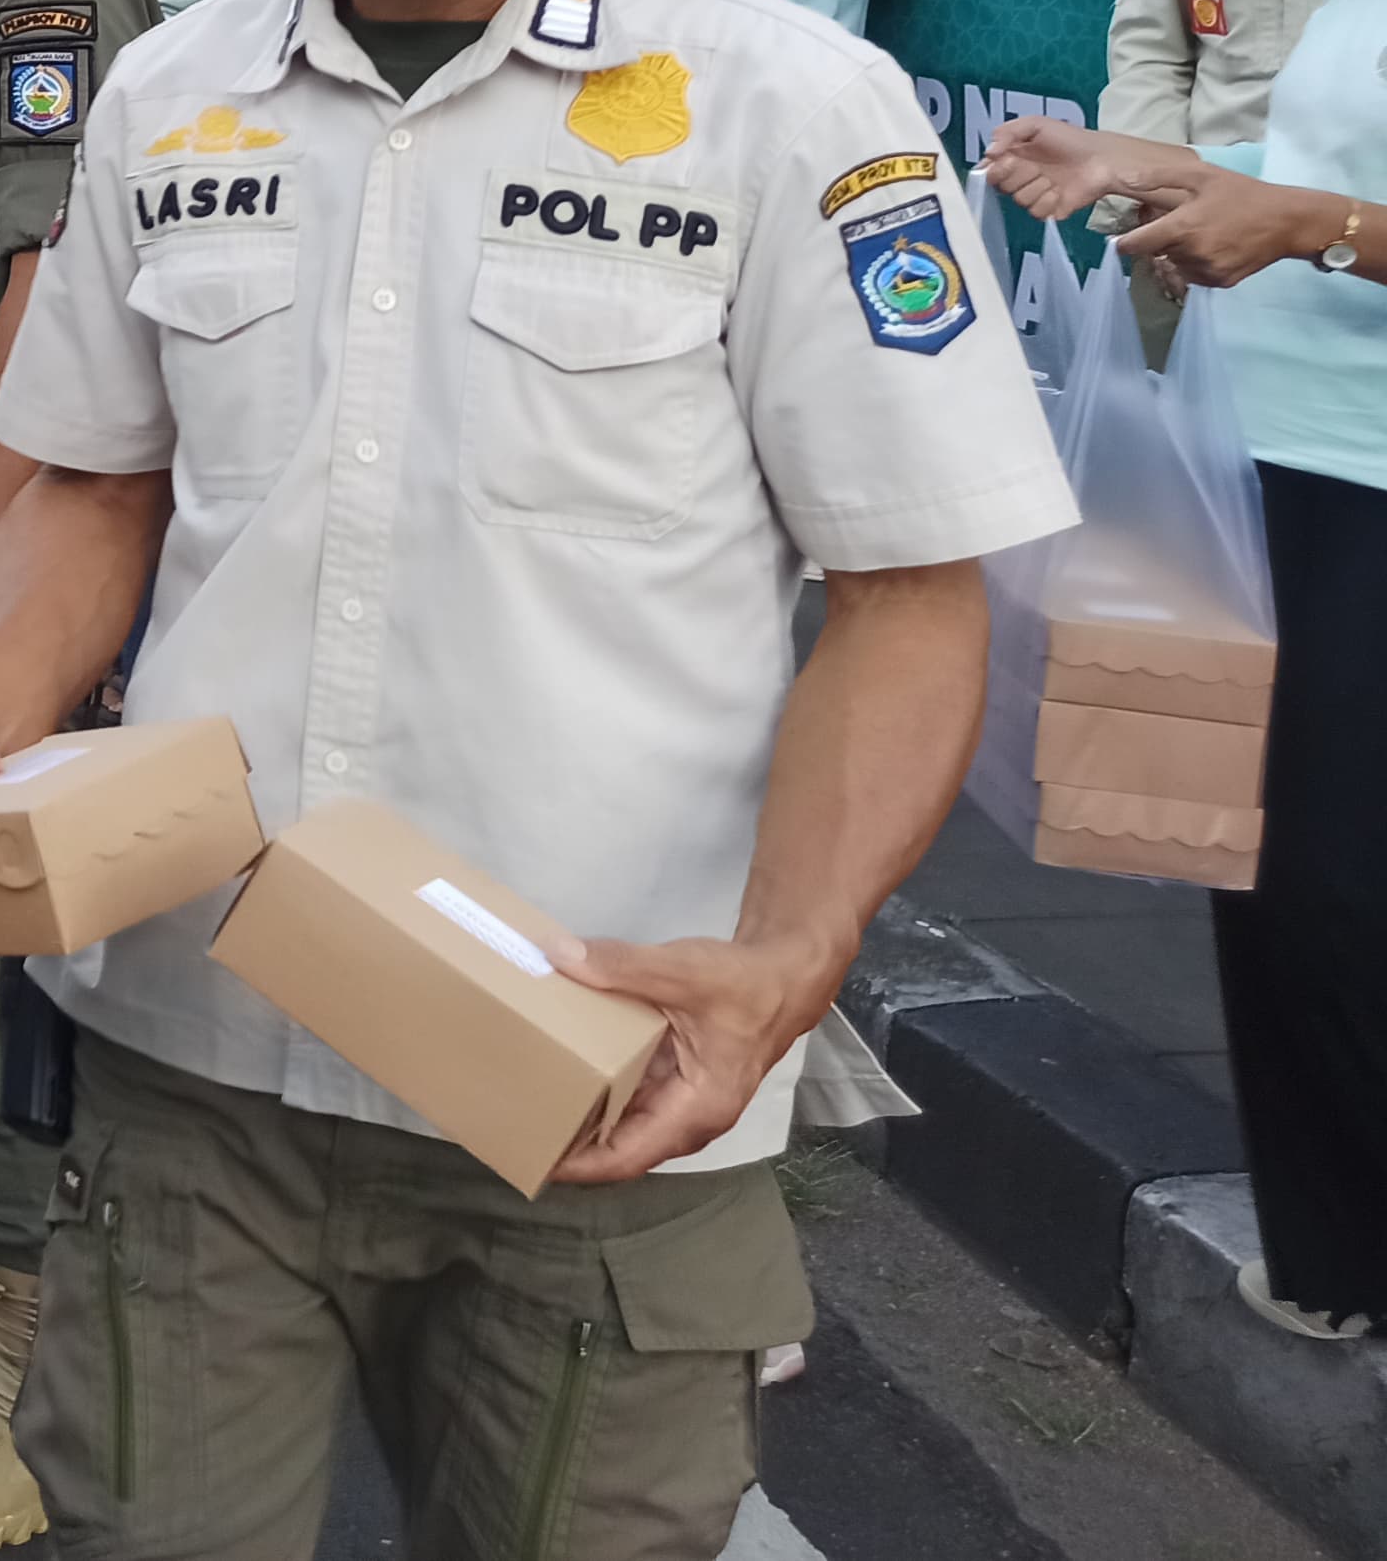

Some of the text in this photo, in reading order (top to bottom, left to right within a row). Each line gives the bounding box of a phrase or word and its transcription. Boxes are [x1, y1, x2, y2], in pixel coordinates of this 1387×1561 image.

[136, 174, 280, 230] LASRI
[501, 183, 719, 256] POL PP
